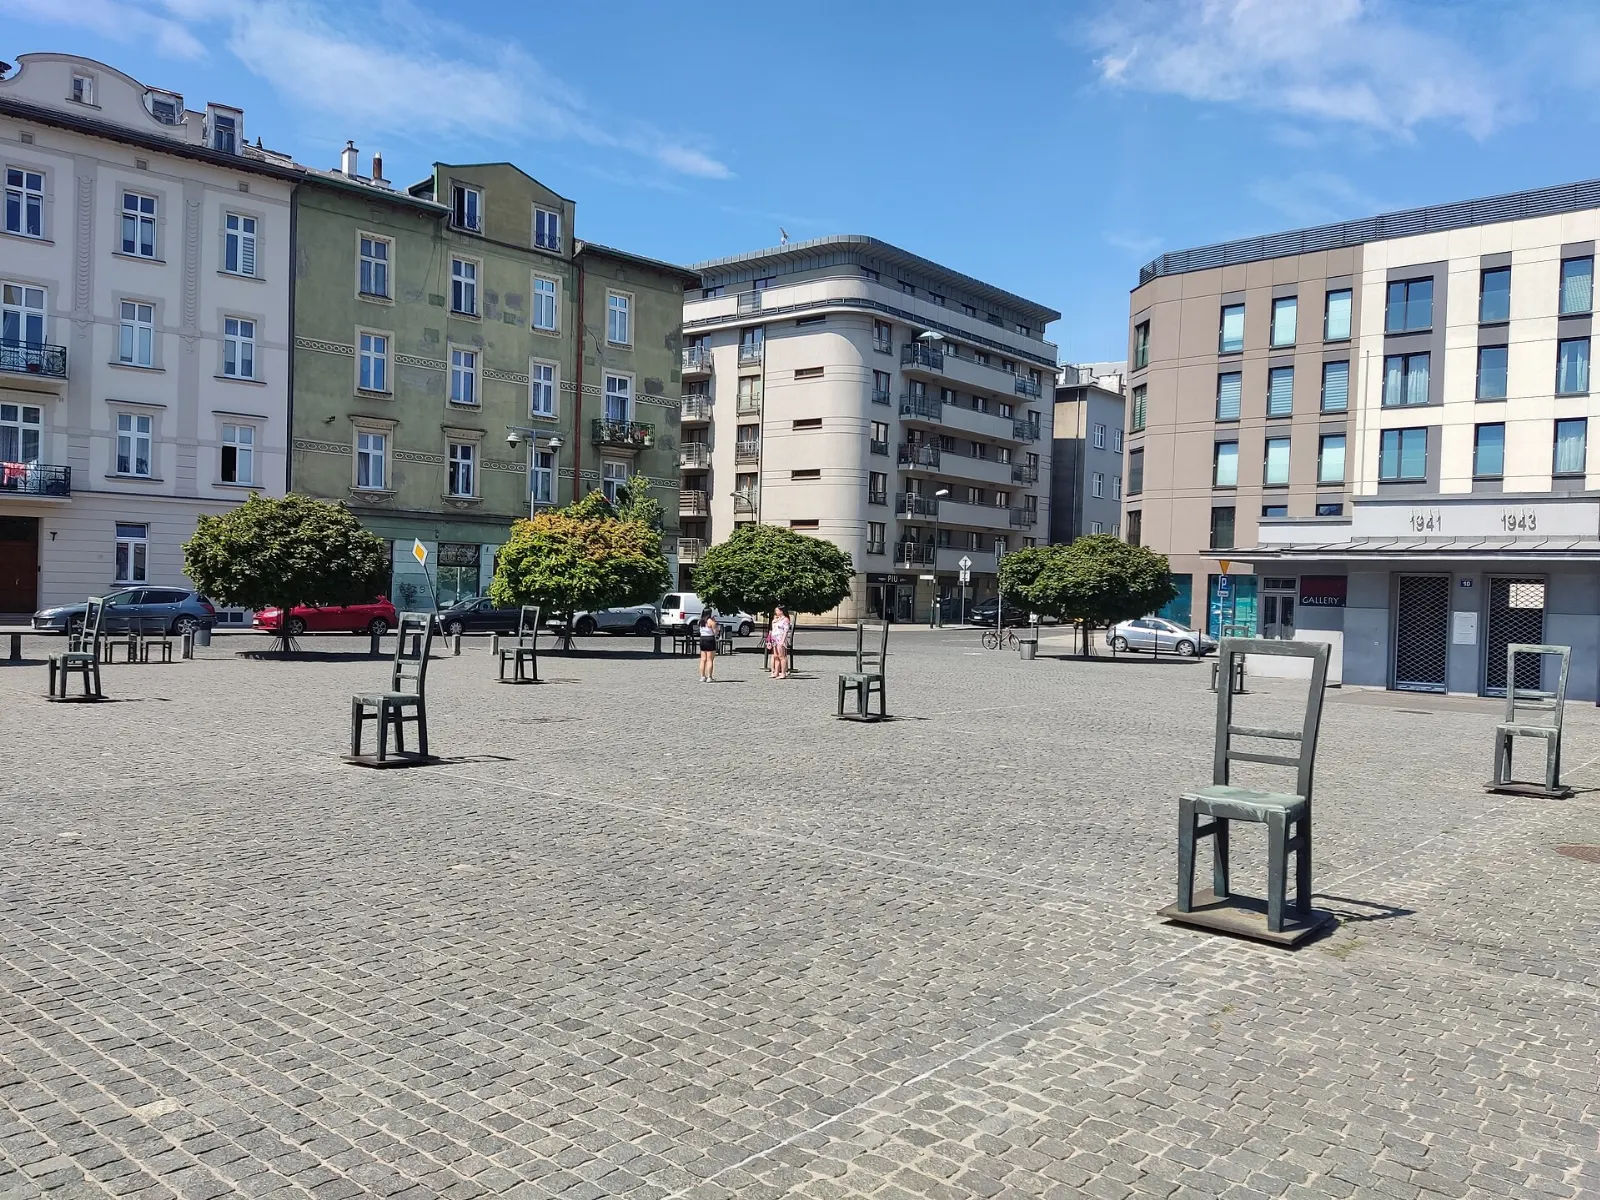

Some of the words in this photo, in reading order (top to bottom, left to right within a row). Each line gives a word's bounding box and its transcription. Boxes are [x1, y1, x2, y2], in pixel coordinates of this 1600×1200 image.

[1409, 510, 1442, 532] 1941
[1500, 509, 1537, 532] 1943
[1302, 596, 1340, 605] GALLERY
